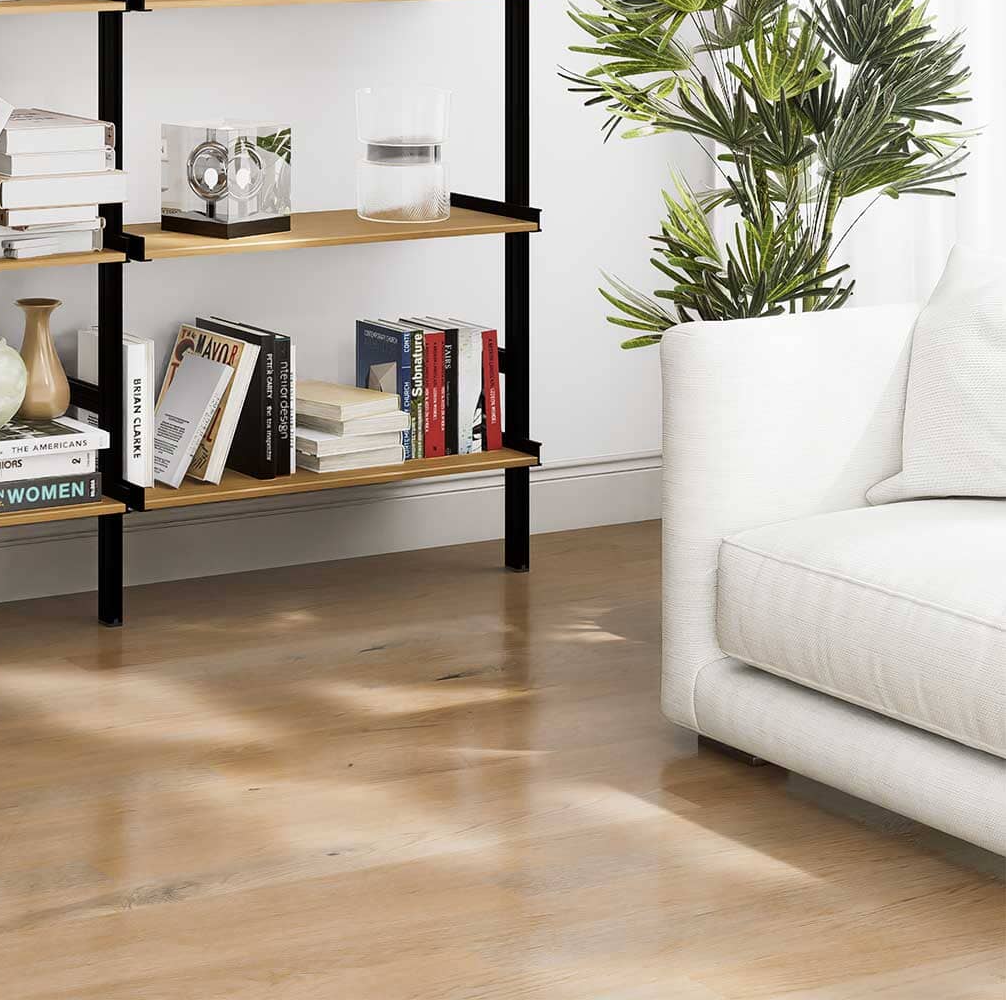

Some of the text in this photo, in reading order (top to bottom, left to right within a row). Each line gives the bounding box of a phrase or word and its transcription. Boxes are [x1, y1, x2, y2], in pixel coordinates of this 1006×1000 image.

[194, 333, 239, 366] MAYOR
[444, 344, 452, 370] FAIRS
[412, 333, 423, 397] Subnature
[403, 381, 411, 407] CHURCH
[133, 378, 142, 459] BRIAN CLARKE
[278, 400, 289, 440] design
[11, 439, 88, 455] THE AMERICANS
[6, 481, 85, 505] WOMEN
